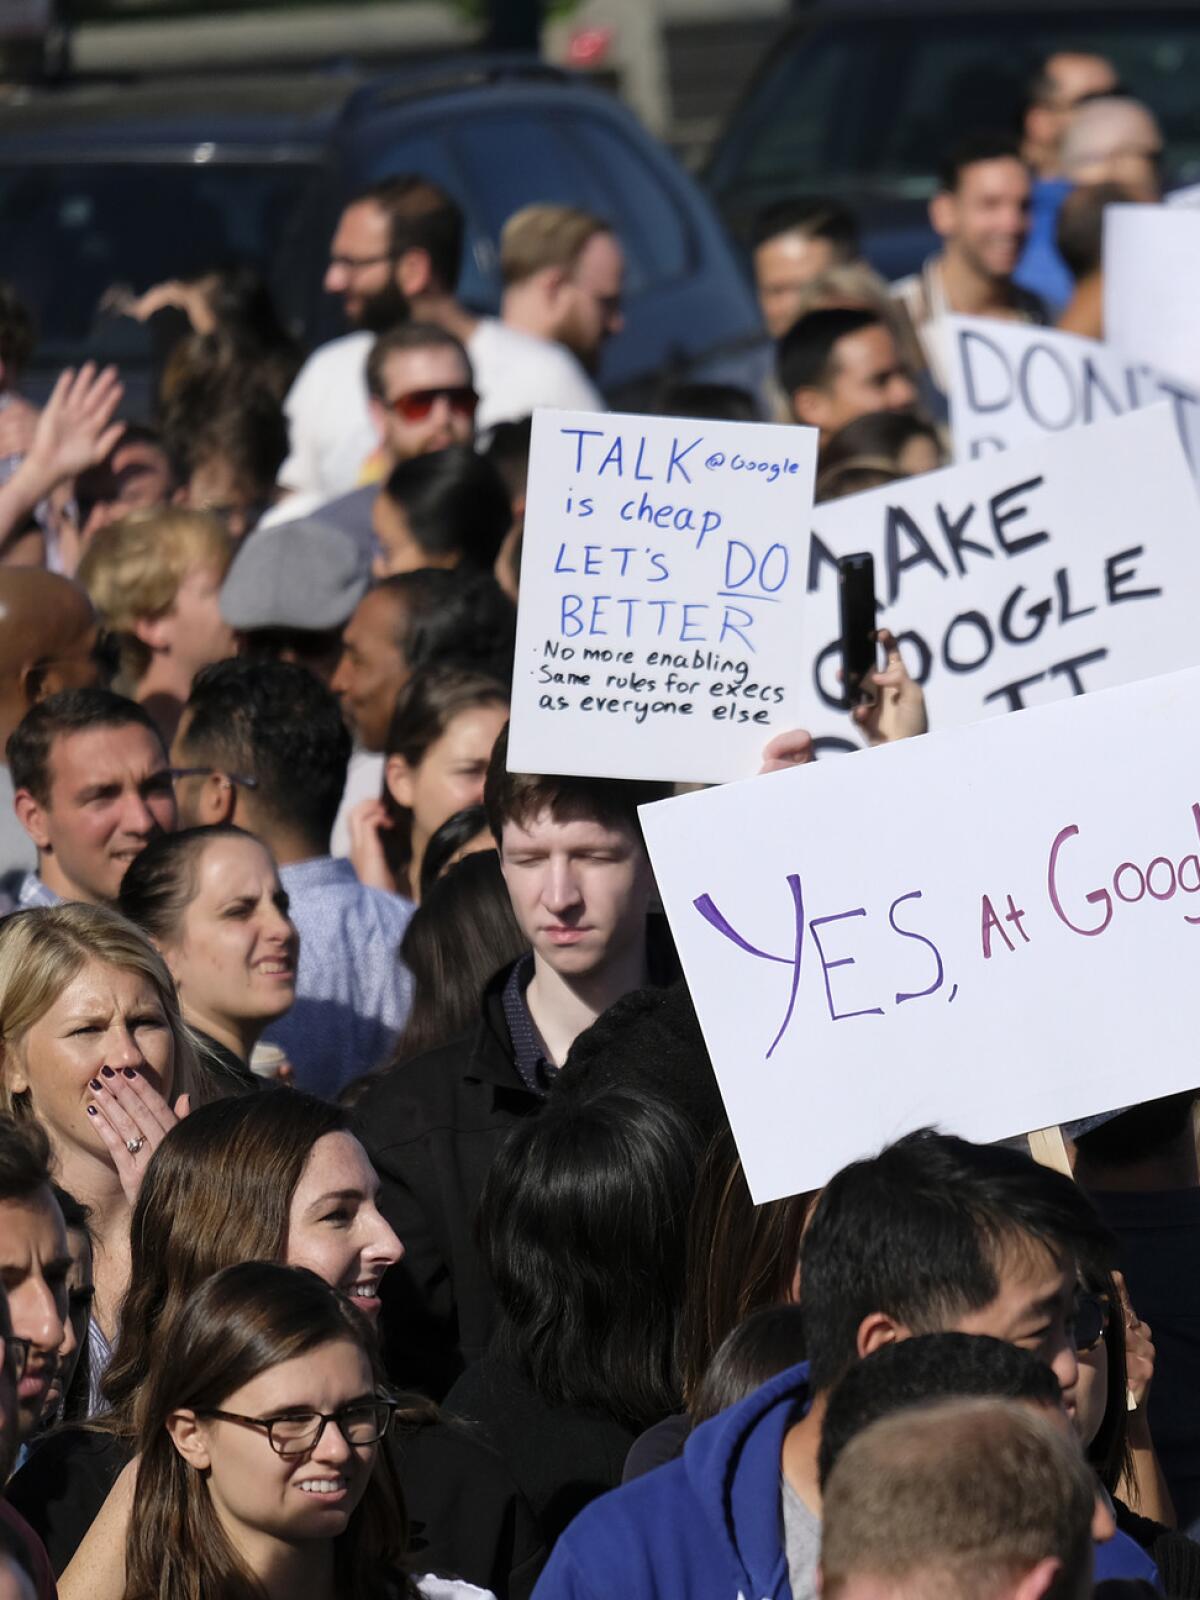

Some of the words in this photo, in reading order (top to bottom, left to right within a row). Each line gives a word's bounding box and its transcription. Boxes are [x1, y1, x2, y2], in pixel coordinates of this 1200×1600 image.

[560, 429, 704, 484] TALK
[566, 487, 594, 517] is
[620, 492, 721, 549] cheap
[554, 543, 669, 582] LET'S
[724, 540, 789, 593] DO
[560, 594, 757, 653] BETTER
[538, 665, 591, 686] Same
[606, 672, 656, 694] rules
[664, 672, 700, 695] for
[709, 681, 785, 704] execs
[543, 640, 575, 661] No
[583, 647, 634, 664] more
[646, 648, 749, 684] enabling
[538, 694, 569, 712] as
[579, 694, 694, 724] everyone
[711, 702, 772, 726] else
[692, 873, 959, 1060] YES,
[981, 893, 1031, 959] At
